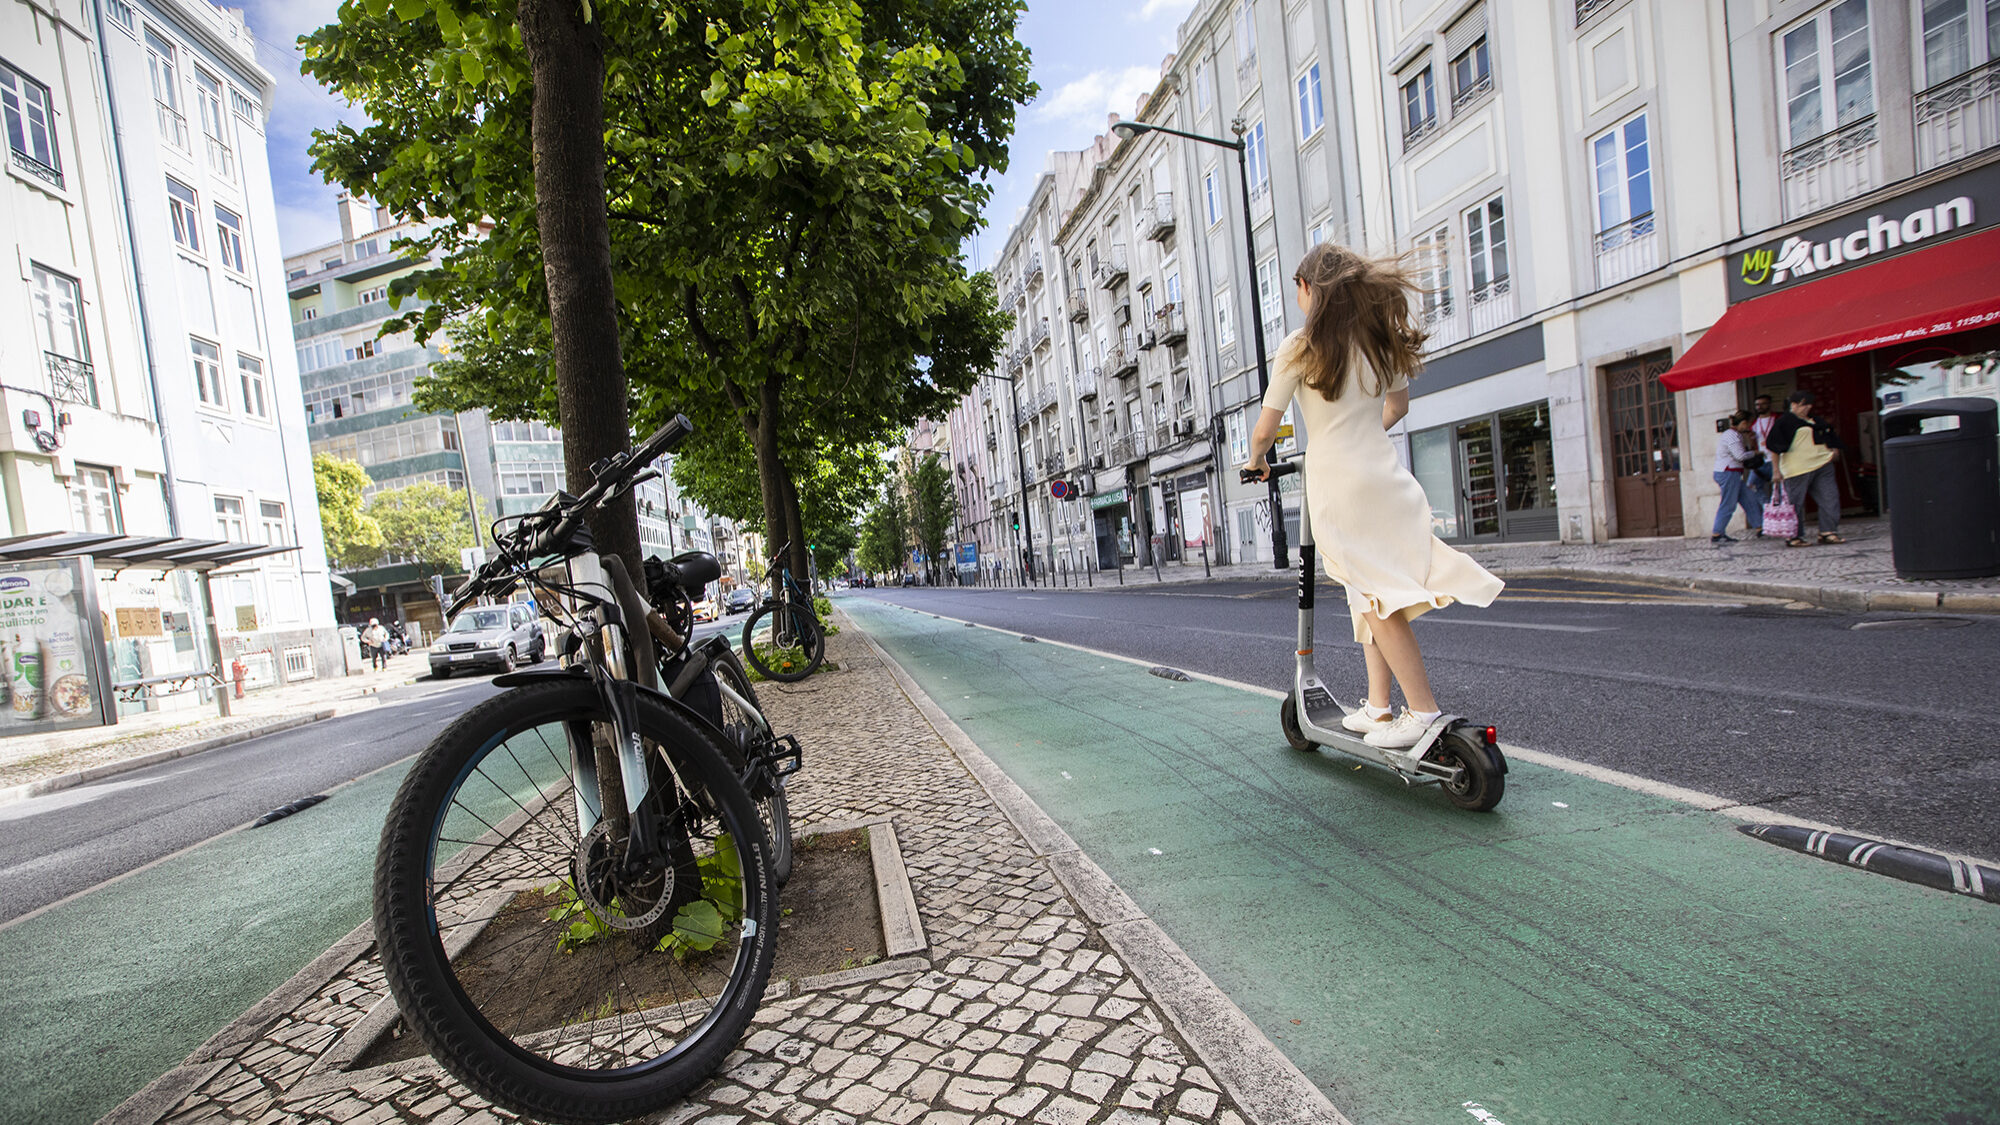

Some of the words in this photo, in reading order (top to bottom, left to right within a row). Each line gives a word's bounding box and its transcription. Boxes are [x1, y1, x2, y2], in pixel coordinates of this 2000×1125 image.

[1740, 248, 1774, 286] My
[1771, 196, 1976, 286] Auchan
[1956, 311, 2000, 328] 1150-01
